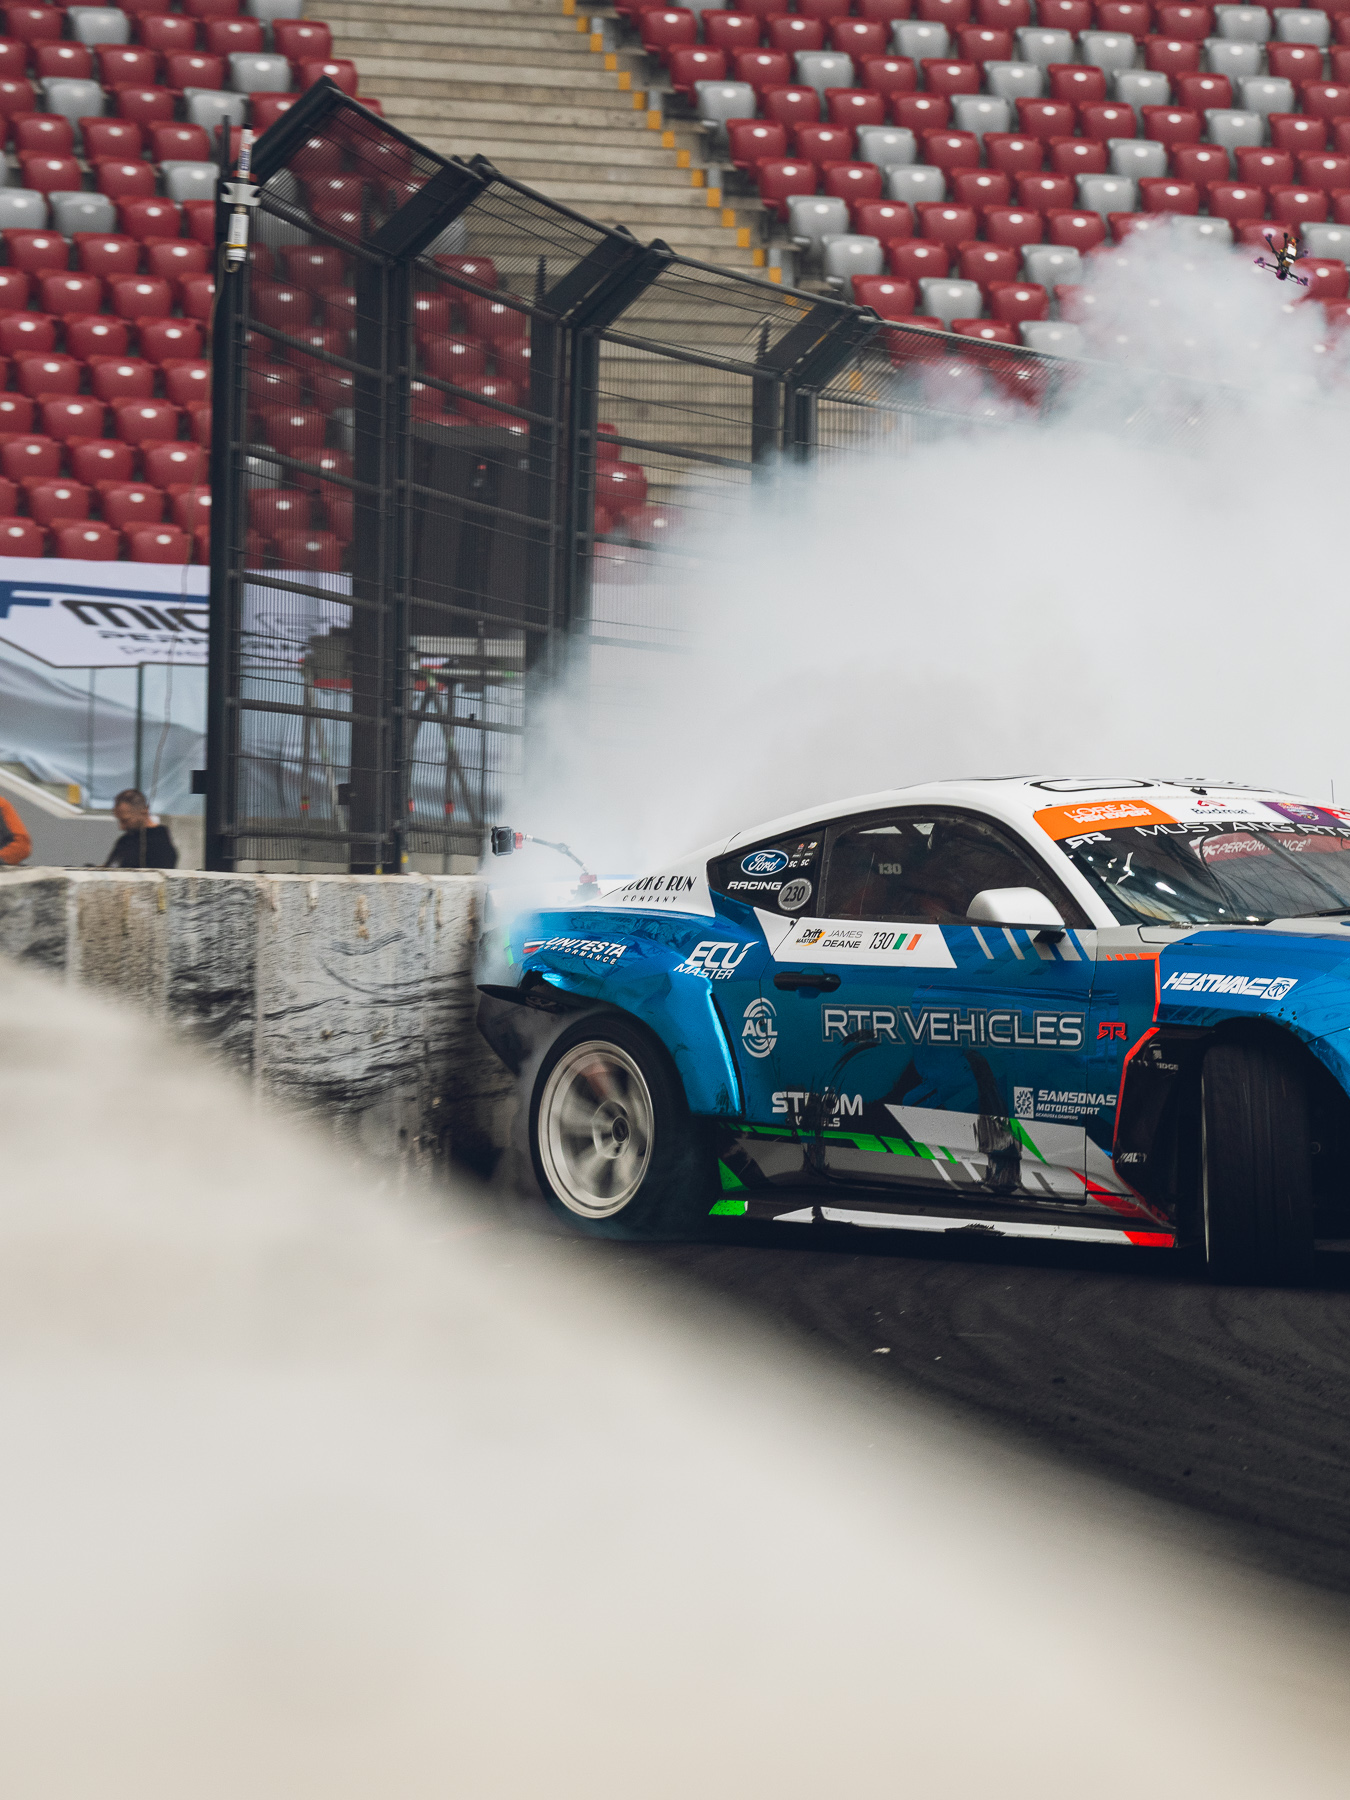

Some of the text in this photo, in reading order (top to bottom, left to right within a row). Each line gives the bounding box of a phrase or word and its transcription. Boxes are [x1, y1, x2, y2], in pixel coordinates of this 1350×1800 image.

[748, 852, 783, 872] Ford
[878, 863, 902, 874] 130
[666, 876, 697, 891] RUN
[727, 881, 783, 891] RACING
[622, 894, 677, 903] COMPANY
[783, 885, 806, 902] 230
[803, 928, 823, 939] Drift
[828, 929, 864, 939] JAMES
[868, 931, 896, 950] 130
[546, 936, 627, 958] UNITESTA
[822, 939, 862, 949] DEANE
[685, 940, 760, 969] ECU
[673, 962, 735, 980] MASTER
[1161, 971, 1274, 996] HEATWAVE
[741, 1019, 778, 1037] ACL
[824, 1008, 1083, 1047] RTR VEHICLES
[1038, 1089, 1117, 1106] SAMSONAS
[1036, 1103, 1100, 1115] MOTORSPORT
